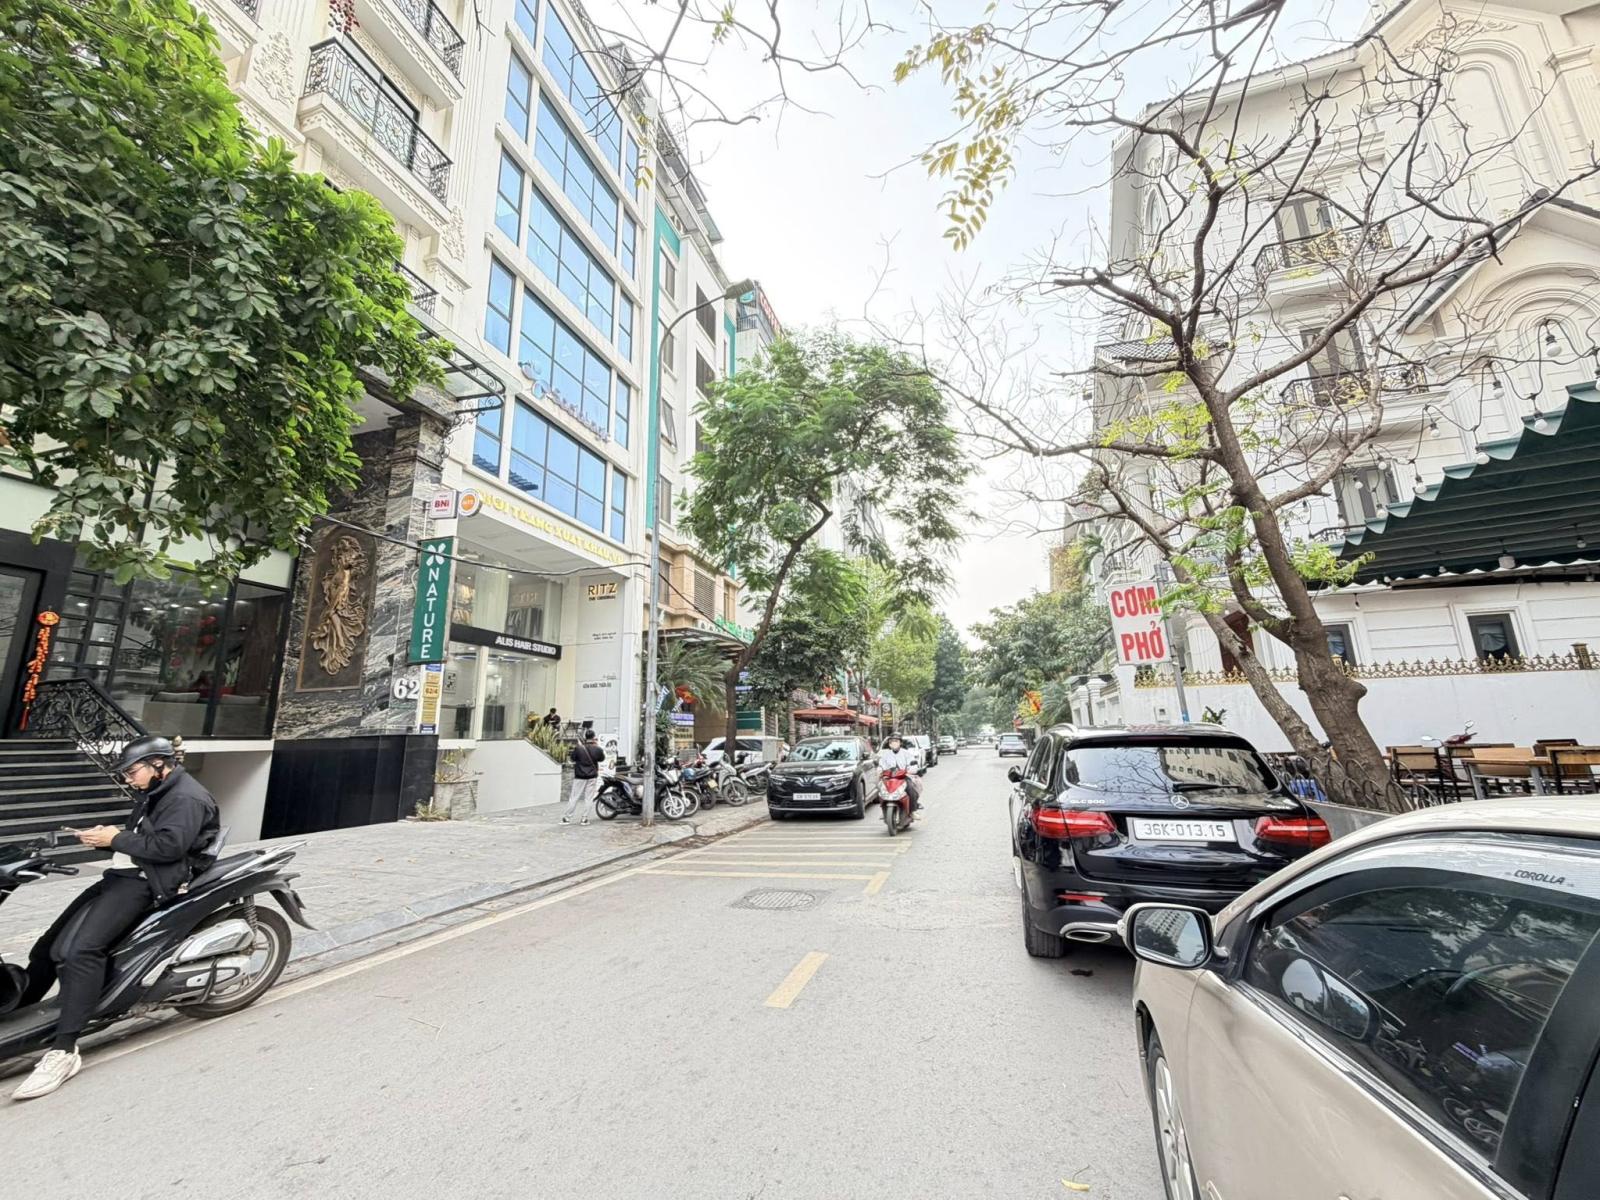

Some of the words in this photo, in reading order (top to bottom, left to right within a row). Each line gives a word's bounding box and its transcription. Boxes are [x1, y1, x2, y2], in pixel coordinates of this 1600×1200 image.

[588, 583, 616, 595] RITZ
[1111, 586, 1159, 618] CƠM
[420, 568, 439, 659] NATURE
[495, 636, 513, 647] ALIS
[514, 639, 532, 651] HAIR
[532, 643, 556, 655] STUDIO
[1121, 620, 1164, 661] PHỞ
[394, 678, 420, 700] 62
[1144, 824, 1226, 837] 36K-013.15
[1514, 869, 1566, 885] COROLLA
